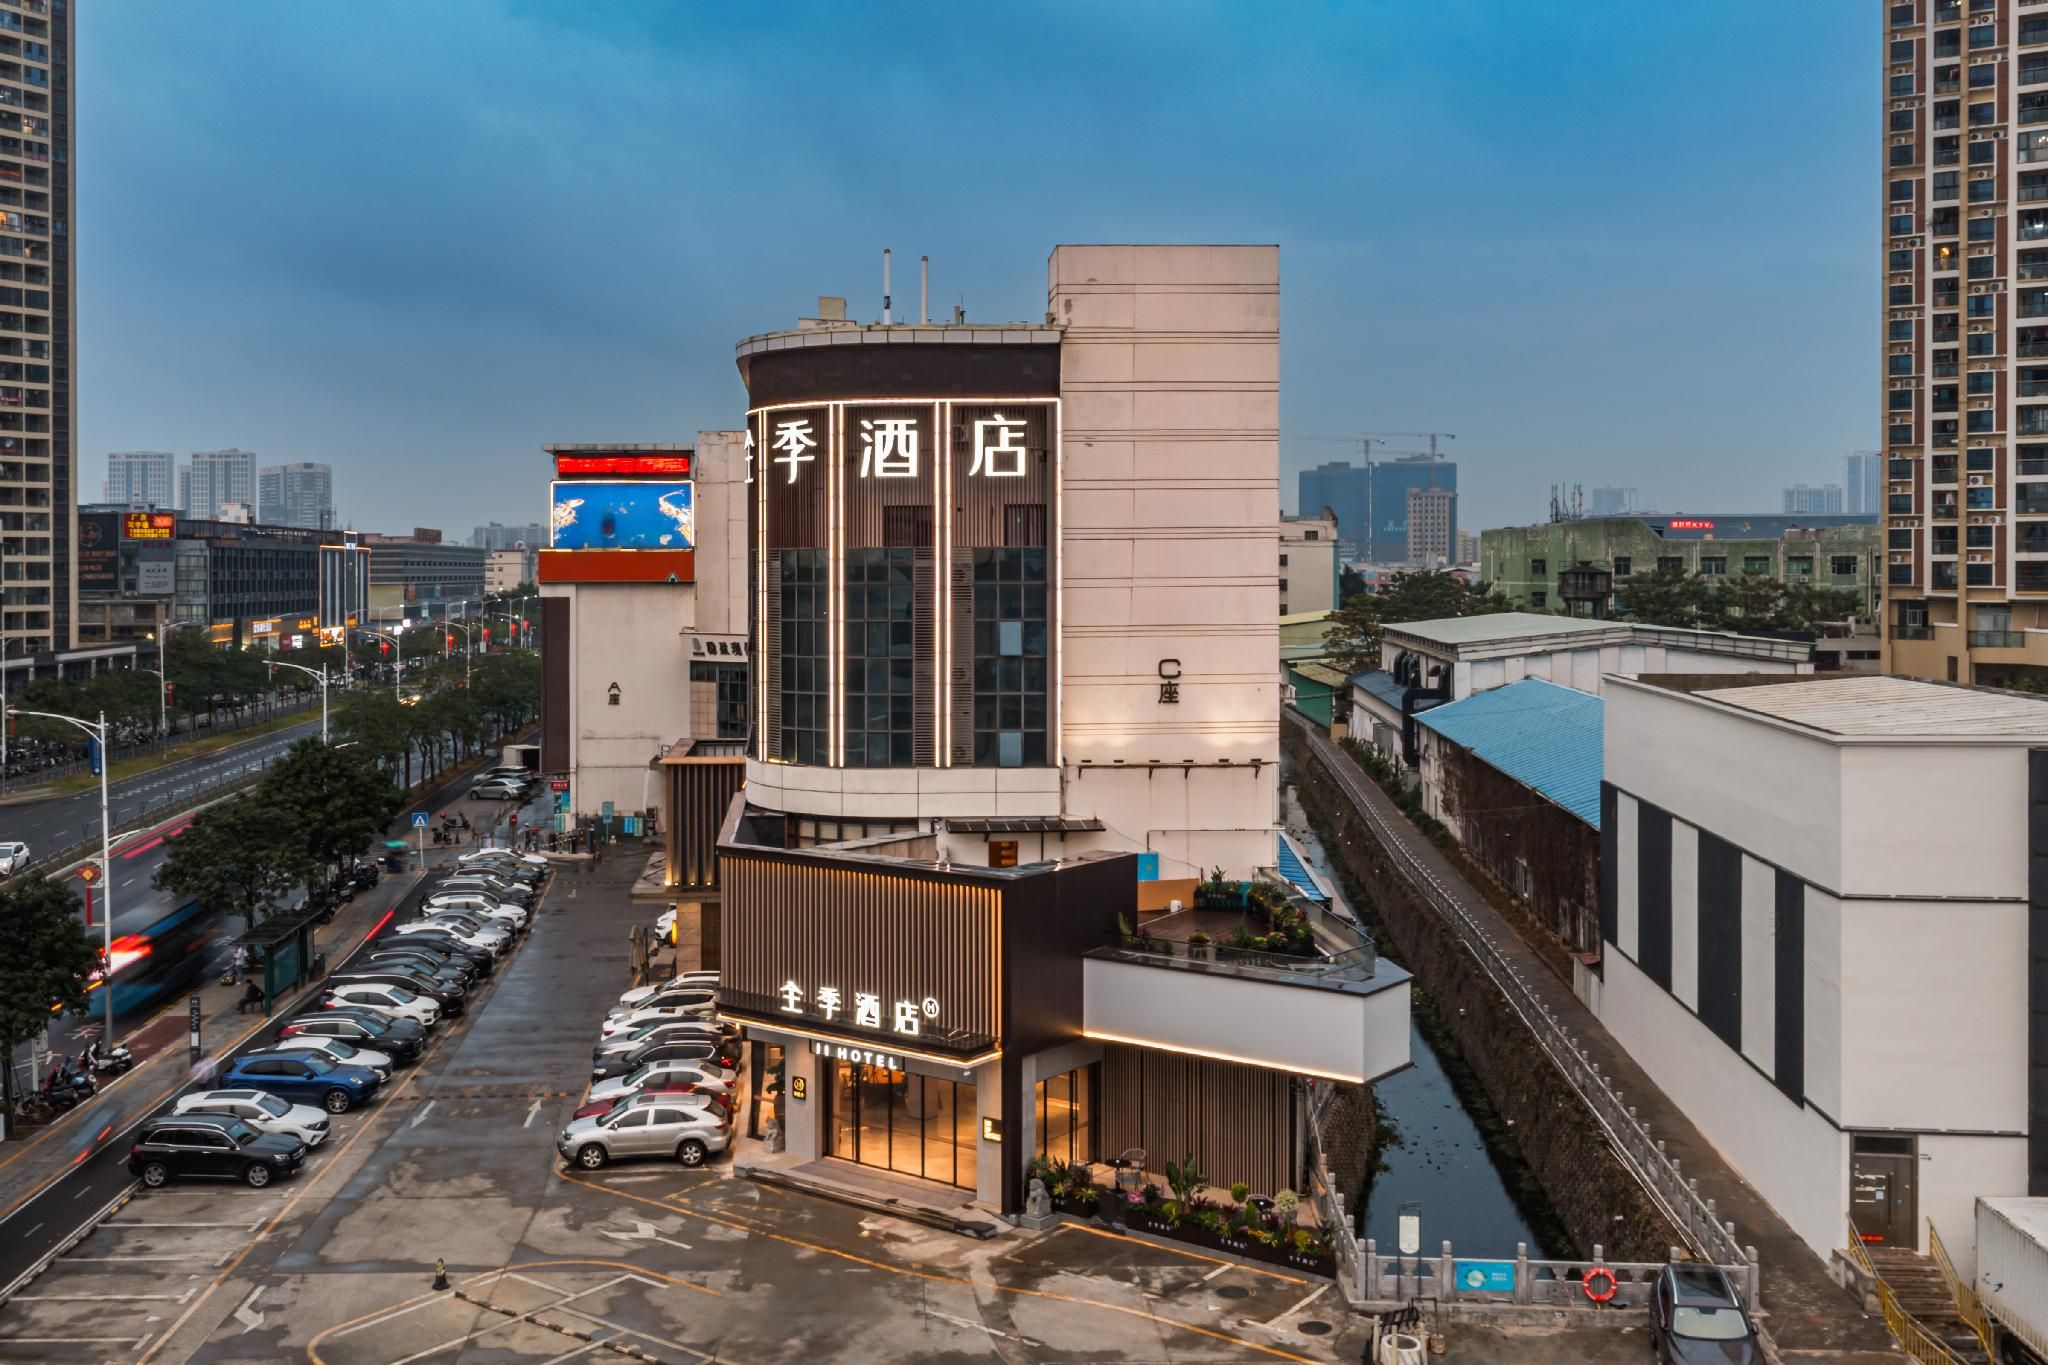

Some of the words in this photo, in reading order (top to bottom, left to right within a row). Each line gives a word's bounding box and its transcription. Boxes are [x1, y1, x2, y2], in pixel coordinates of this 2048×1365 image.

[1158, 659, 1181, 704] C座
[780, 980, 919, 1035] 全季酒店
[837, 1047, 897, 1070] HOTEL
